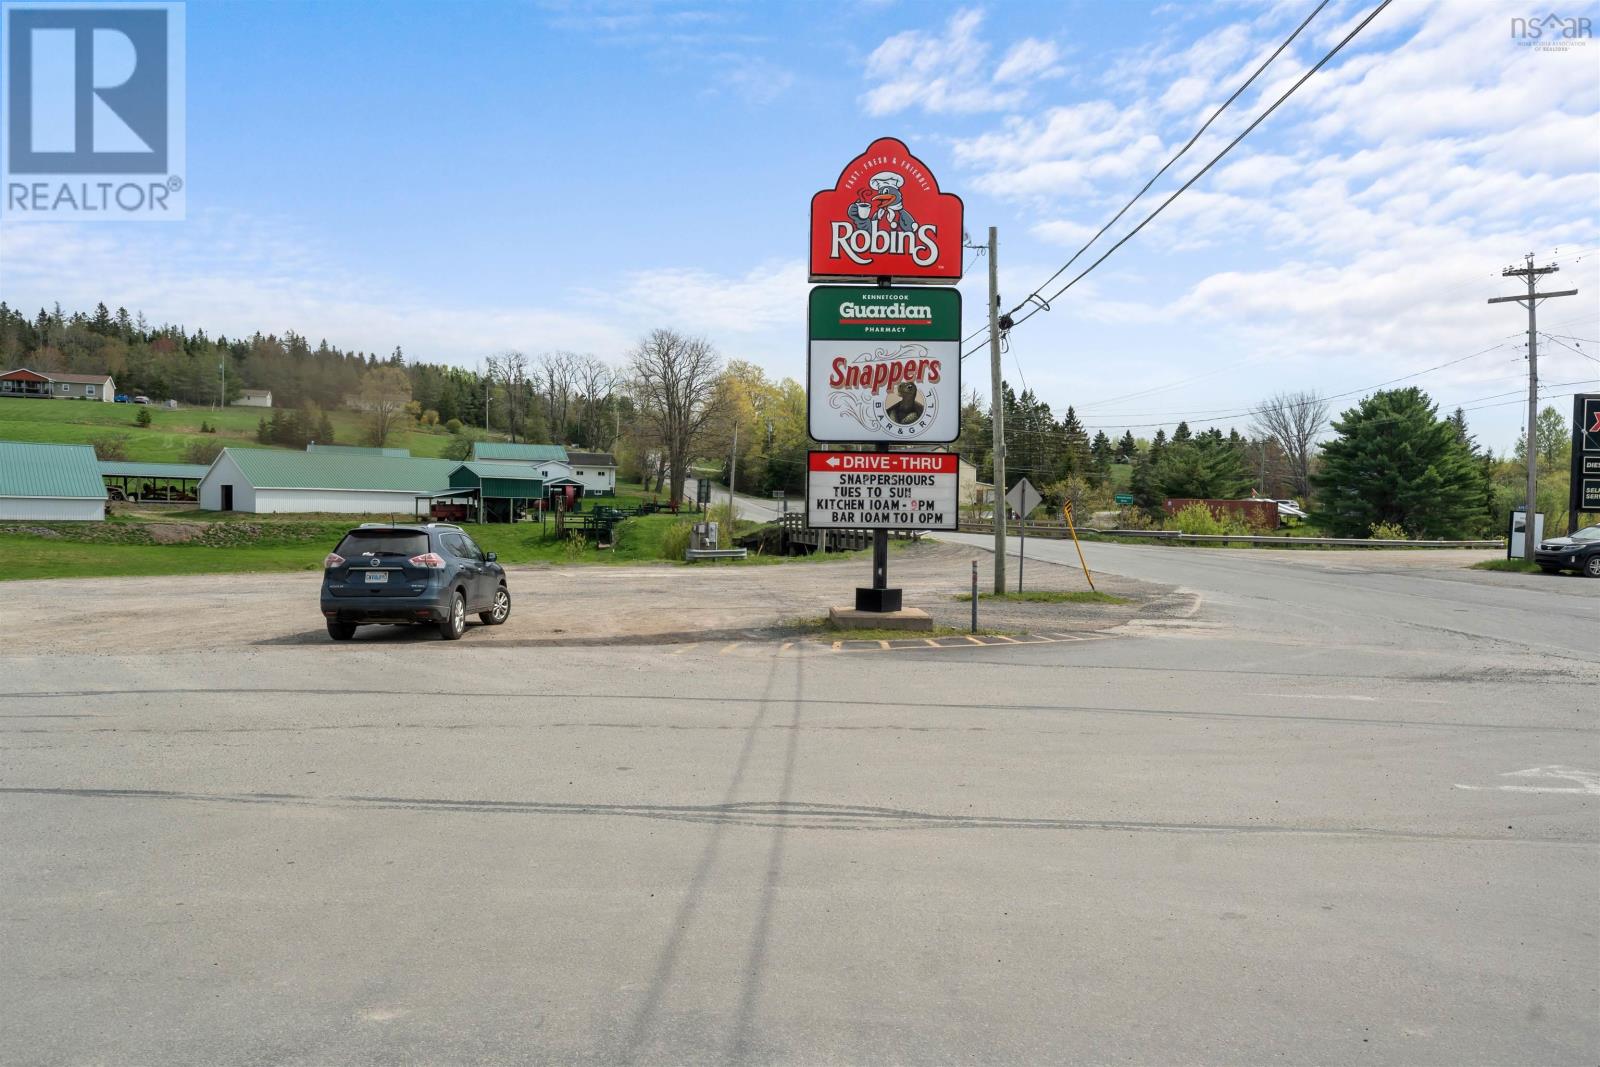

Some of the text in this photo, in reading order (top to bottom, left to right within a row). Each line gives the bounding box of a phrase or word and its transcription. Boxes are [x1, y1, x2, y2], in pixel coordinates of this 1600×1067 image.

[839, 301, 932, 319] Guardian
[829, 356, 941, 396] Snappers
[875, 401, 893, 431] BAR
[908, 392, 934, 434] GRILL
[833, 486, 912, 499] TUES TO SUN
[816, 499, 865, 510] KITCHEN
[832, 511, 855, 523] BAR
